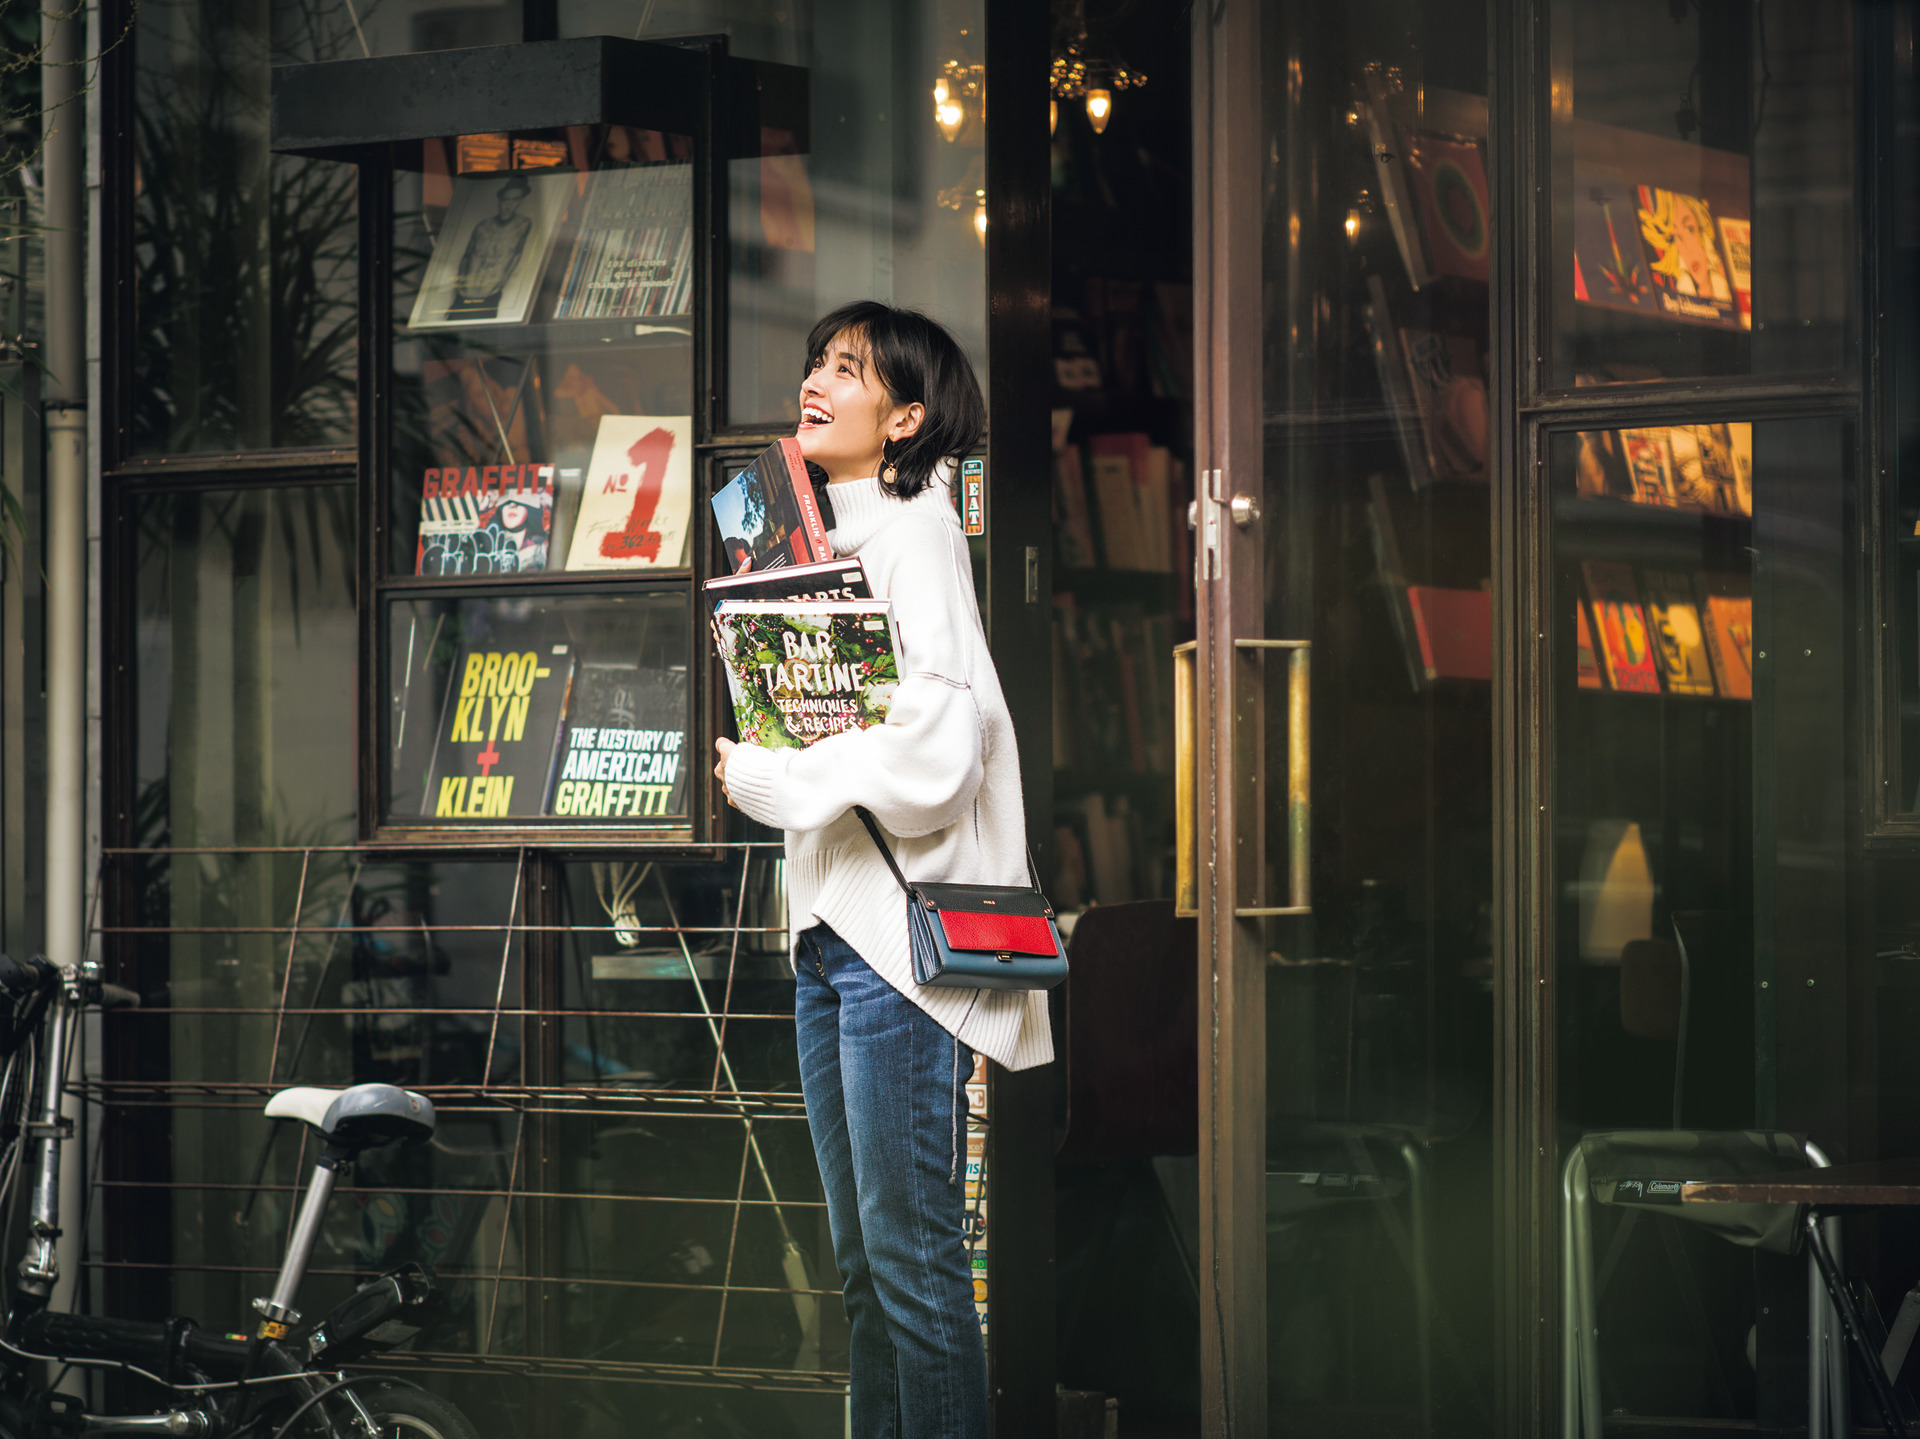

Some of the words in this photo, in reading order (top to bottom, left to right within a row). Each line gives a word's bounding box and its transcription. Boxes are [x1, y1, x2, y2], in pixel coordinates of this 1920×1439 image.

[614, 271, 632, 280] qui
[635, 270, 653, 278] ont
[627, 258, 667, 270] disques
[588, 279, 625, 290] changé
[627, 279, 637, 288] le
[640, 278, 676, 288] monde
[600, 426, 676, 563] 1
[968, 484, 980, 524] EAT
[802, 494, 821, 537] FRANKLIN
[619, 534, 645, 550] 362
[782, 631, 834, 660] BAR
[460, 651, 550, 697] BROO-
[759, 662, 866, 692] TARTINE
[450, 696, 530, 742] KLYN
[777, 698, 858, 718] TECHNIQUES
[570, 727, 597, 749] THE
[597, 728, 663, 751] HISTORY
[662, 730, 684, 751] OF
[803, 715, 858, 733] RECIPES
[561, 750, 680, 784] AMERICAN
[436, 776, 514, 818] KLEIN
[555, 781, 673, 817] GRAFFITI
